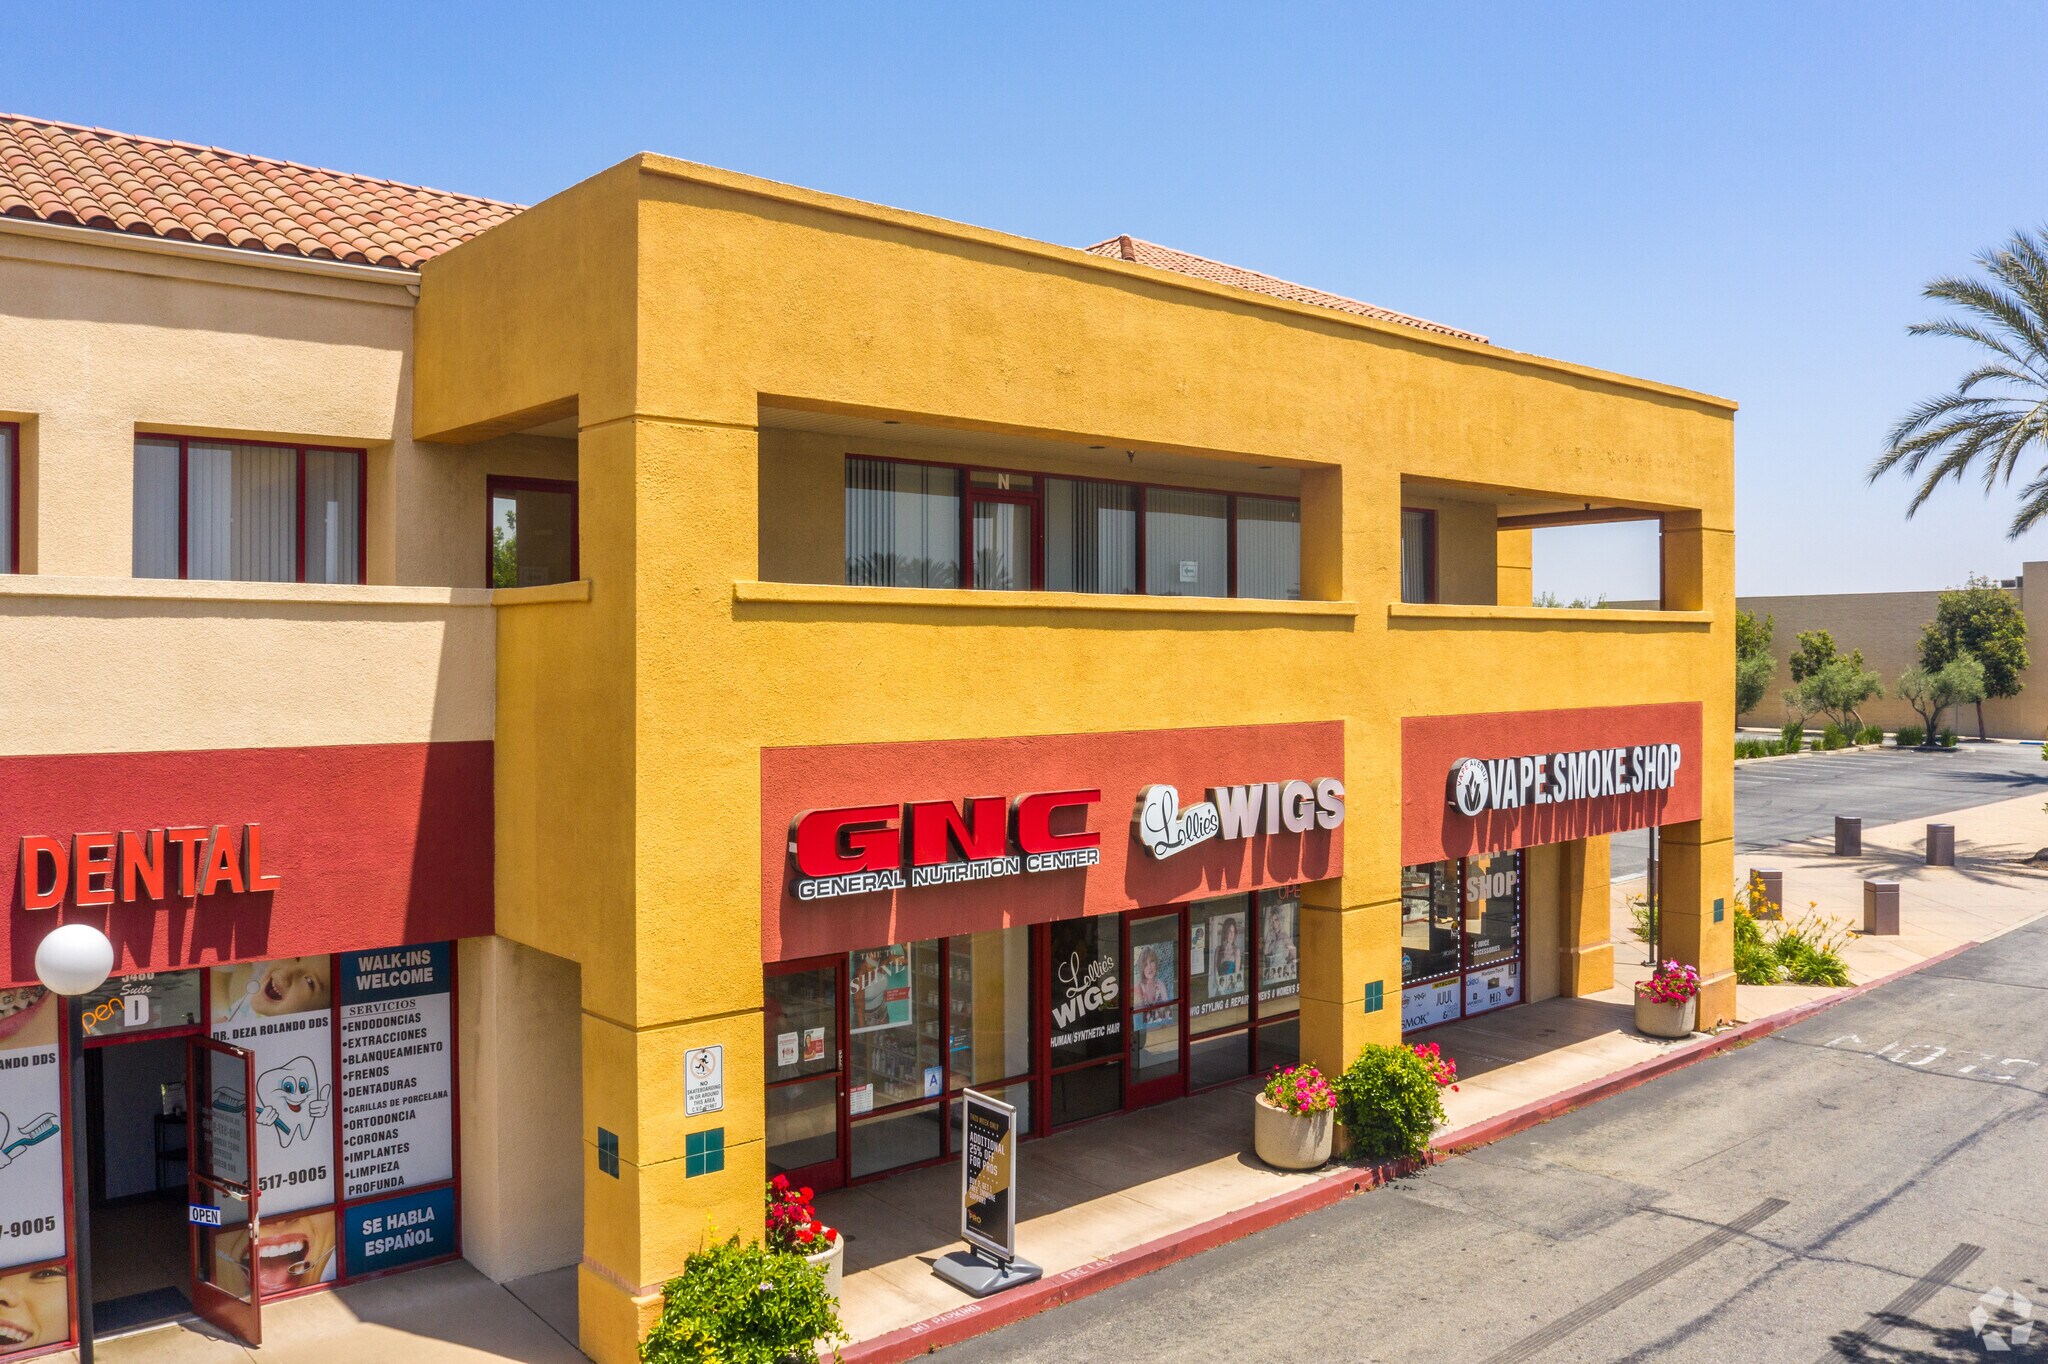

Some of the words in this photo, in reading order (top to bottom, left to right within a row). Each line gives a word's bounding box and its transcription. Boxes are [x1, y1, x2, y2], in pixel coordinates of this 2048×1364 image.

[998, 473, 1010, 491] N
[1208, 777, 1346, 840] WIGS
[789, 788, 1101, 877] GNC
[1145, 790, 1218, 856] Lollie's
[20, 822, 282, 911] DENTAL
[798, 869, 906, 900] GENERAL
[912, 855, 1020, 887] NUTRITION
[1026, 848, 1101, 873] CENTER
[1279, 883, 1301, 900] OPE
[1466, 870, 1517, 903] SHOP
[358, 949, 431, 972] WALK-INS
[1474, 945, 1501, 957] ACCESSORIES
[356, 967, 433, 991] WELCOME
[850, 956, 905, 994] SHINE
[1058, 951, 1115, 998] Lollie's
[120, 984, 152, 996] Suite
[124, 995, 149, 1027] D
[349, 999, 417, 1016] SERVICIOS
[1052, 976, 1119, 1029] WIGS
[1190, 1006, 1200, 1017] WIG
[1201, 1000, 1224, 1014] STYLING
[1225, 999, 1229, 1008] &
[1230, 995, 1250, 1007] REPAIR
[82, 997, 125, 1035] pen
[348, 1012, 422, 1032] ENDODONCIAS
[1402, 1014, 1428, 1030] SMOK
[213, 1030, 230, 1041] DR.
[233, 1028, 257, 1040] DEZA
[260, 1020, 306, 1036] ROLANDO
[309, 1017, 328, 1029] DDS
[348, 1027, 427, 1049] EXTRACCIONES
[1106, 1022, 1120, 1035] HAIR
[33, 1053, 56, 1066] DDS
[348, 1041, 443, 1065] BLANQUEAMIENTO
[348, 1065, 389, 1082] FRENOS
[930, 1074, 938, 1087] A
[349, 1077, 417, 1098] DENTADURAS
[688, 1084, 720, 1095] SKATEBOARDING
[349, 1100, 387, 1114] CARILLAS
[390, 1097, 400, 1107] DE
[402, 1090, 448, 1105] PORCELANA
[349, 1109, 416, 1131] ORTODONCIA
[350, 1128, 399, 1147] CORONAS
[970, 1131, 1005, 1156] ADDITIONAL
[350, 1142, 410, 1164] IMPLANTES
[970, 1143, 982, 1157] 25%
[984, 1149, 995, 1162] OFF
[350, 1160, 400, 1180] LIMPIEZA
[970, 1154, 981, 1168] FOR
[983, 1160, 998, 1176] PROS
[349, 1175, 405, 1196] PROFUNDA
[192, 1207, 218, 1223] OPEN
[362, 1217, 383, 1236] SE
[387, 1206, 435, 1231] HABLA
[365, 1228, 434, 1257] ESPAÑOL
[910, 1321, 930, 1333] NO
[931, 1304, 982, 1325] PARKING
